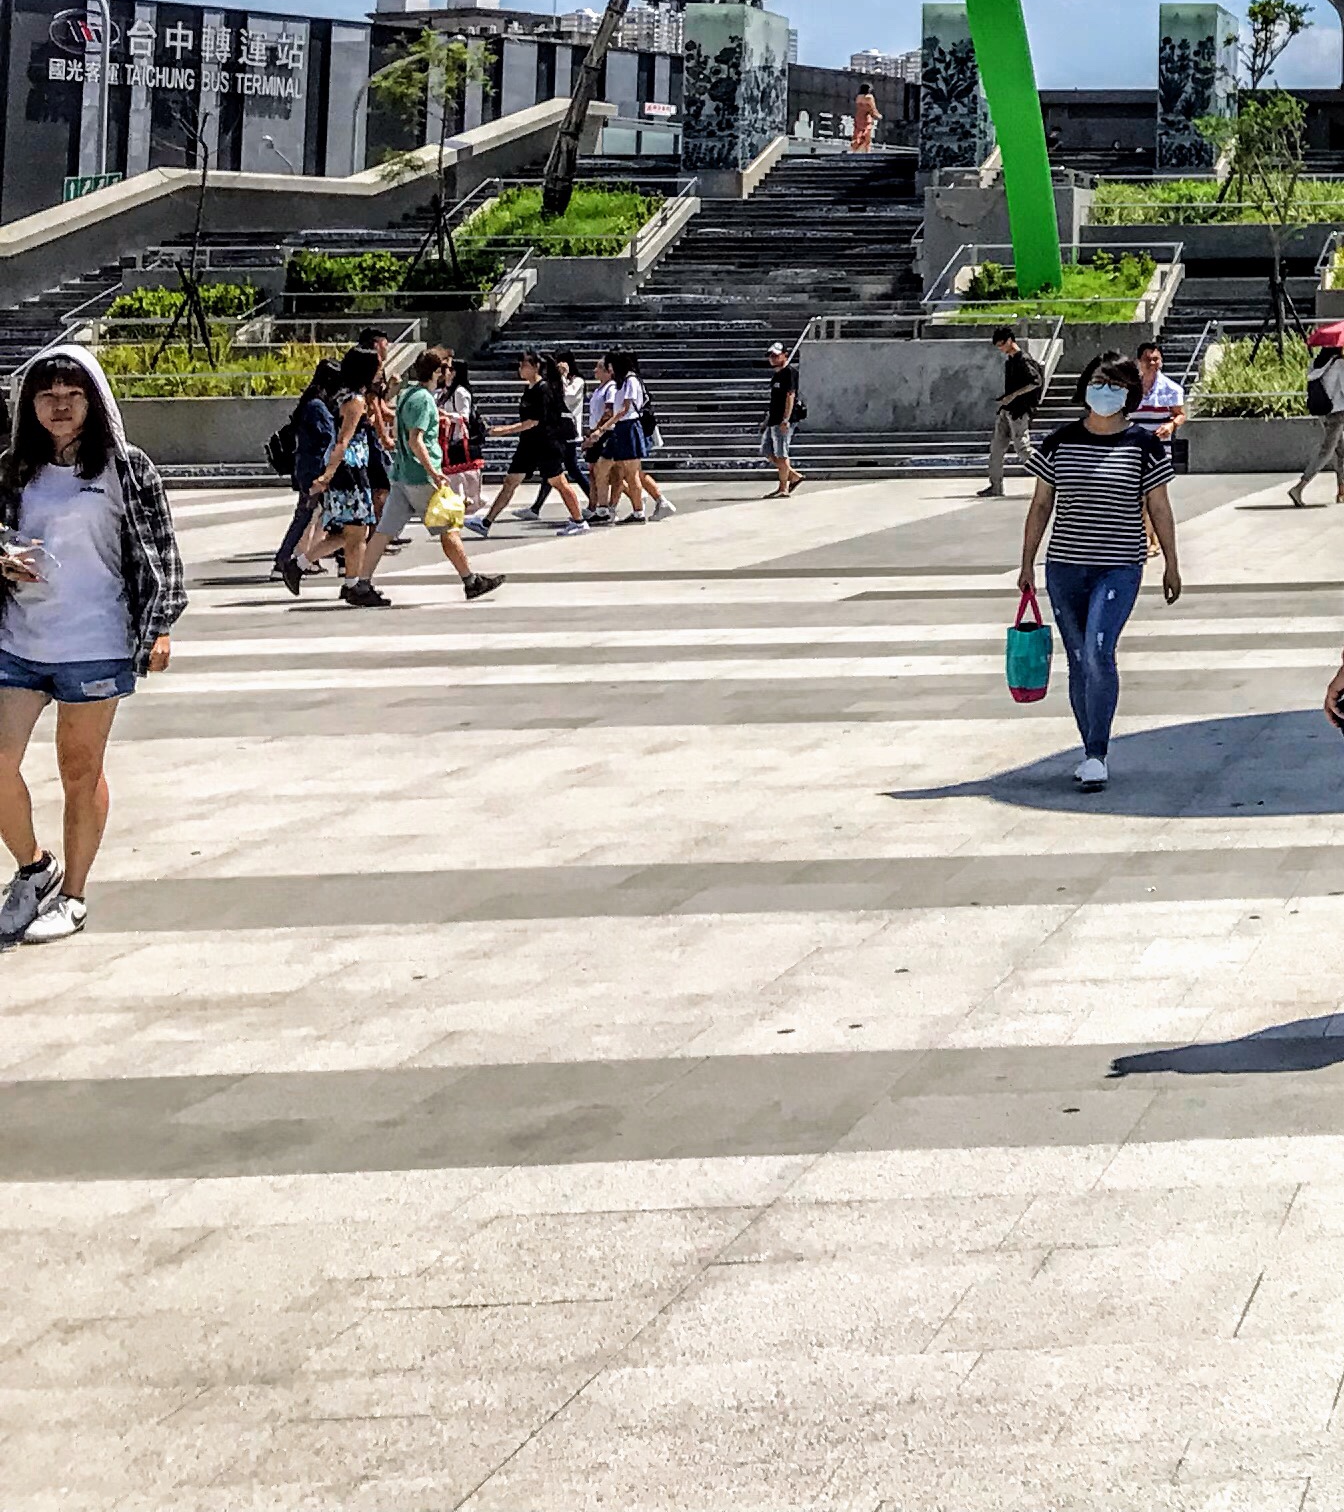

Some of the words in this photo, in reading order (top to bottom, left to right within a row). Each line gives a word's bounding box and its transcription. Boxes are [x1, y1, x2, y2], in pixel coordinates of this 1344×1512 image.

[127, 20, 306, 70] 台中轉運站
[125, 64, 195, 90] TAICHUNG
[201, 71, 230, 93] BUS
[235, 73, 303, 98] TERMINAL
